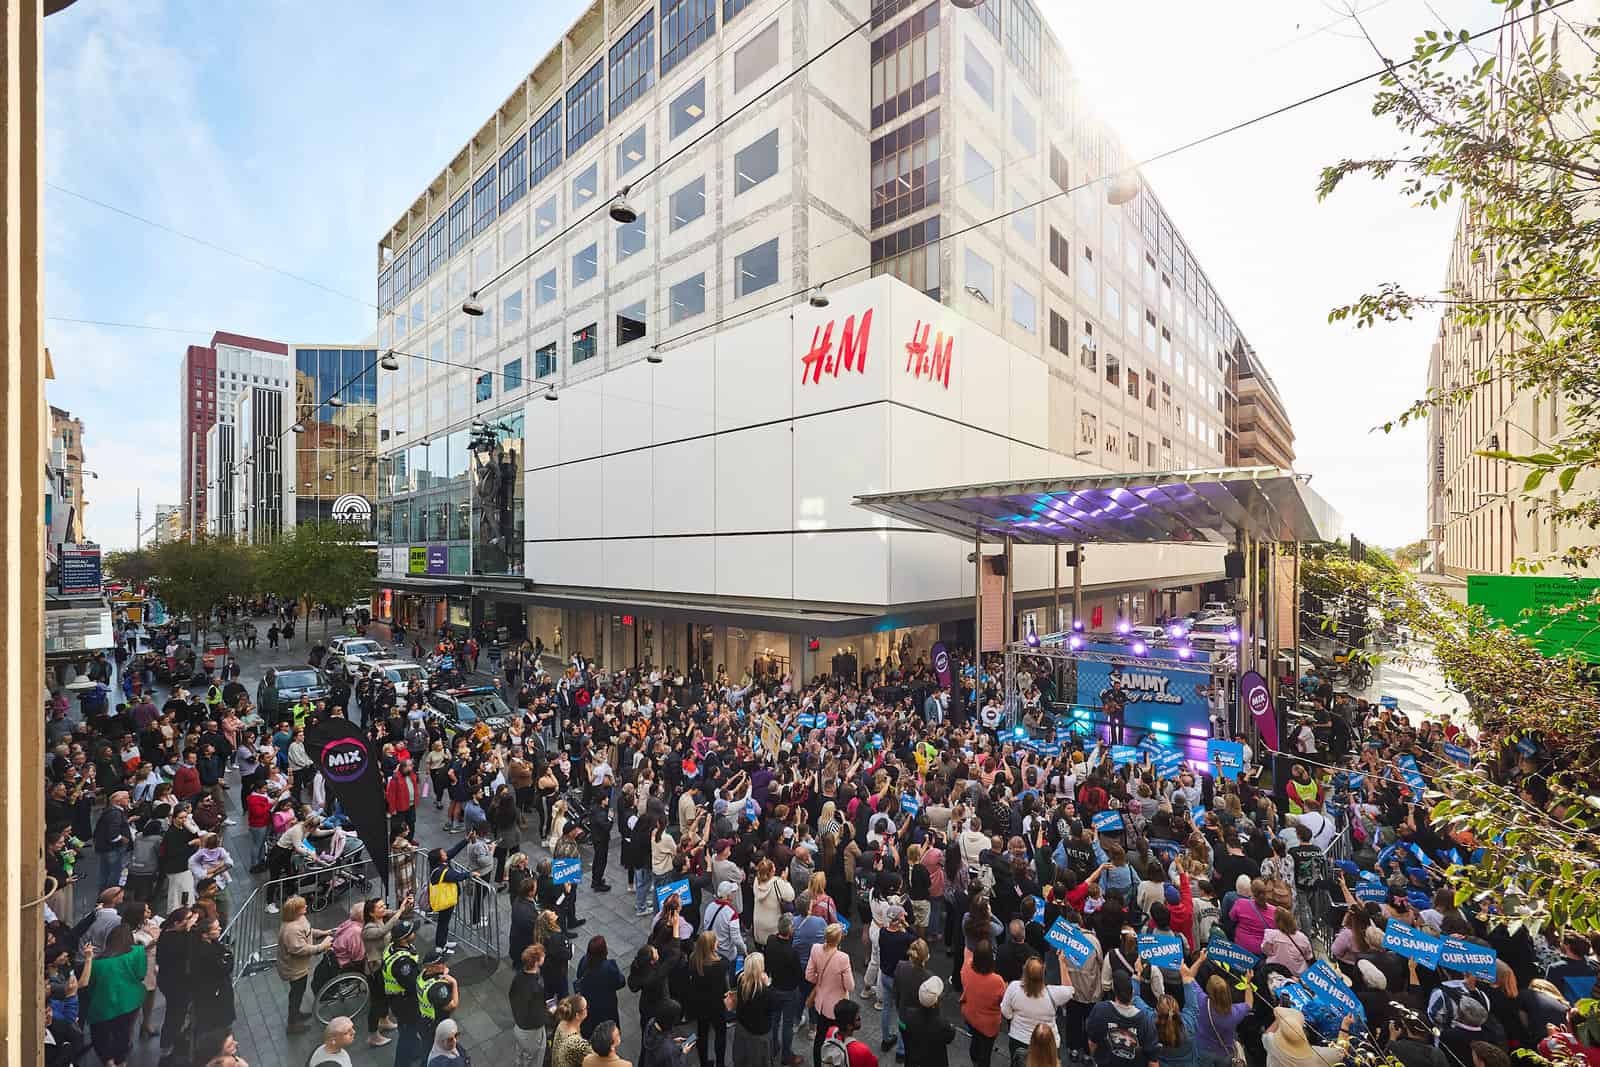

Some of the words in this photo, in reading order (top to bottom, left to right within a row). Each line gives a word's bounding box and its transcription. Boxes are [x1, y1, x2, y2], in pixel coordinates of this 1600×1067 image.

[801, 308, 873, 385] H&M
[905, 319, 953, 390] H&M
[1252, 693, 1265, 706] MIX
[328, 750, 361, 767] MIX
[554, 872, 563, 880] GO
[1050, 930, 1068, 943] OUR
[1067, 937, 1089, 955] HERO
[1141, 950, 1152, 959] GO
[1151, 943, 1180, 956] SAMMY
[1386, 935, 1401, 946] GO
[1402, 939, 1439, 953] SAMMY
[1208, 947, 1227, 957] OUR
[1227, 952, 1254, 963] HERO
[1442, 953, 1465, 963] OUR
[1467, 954, 1494, 965] HERO
[1307, 971, 1328, 992] OUR
[1329, 985, 1356, 1009] HERO
